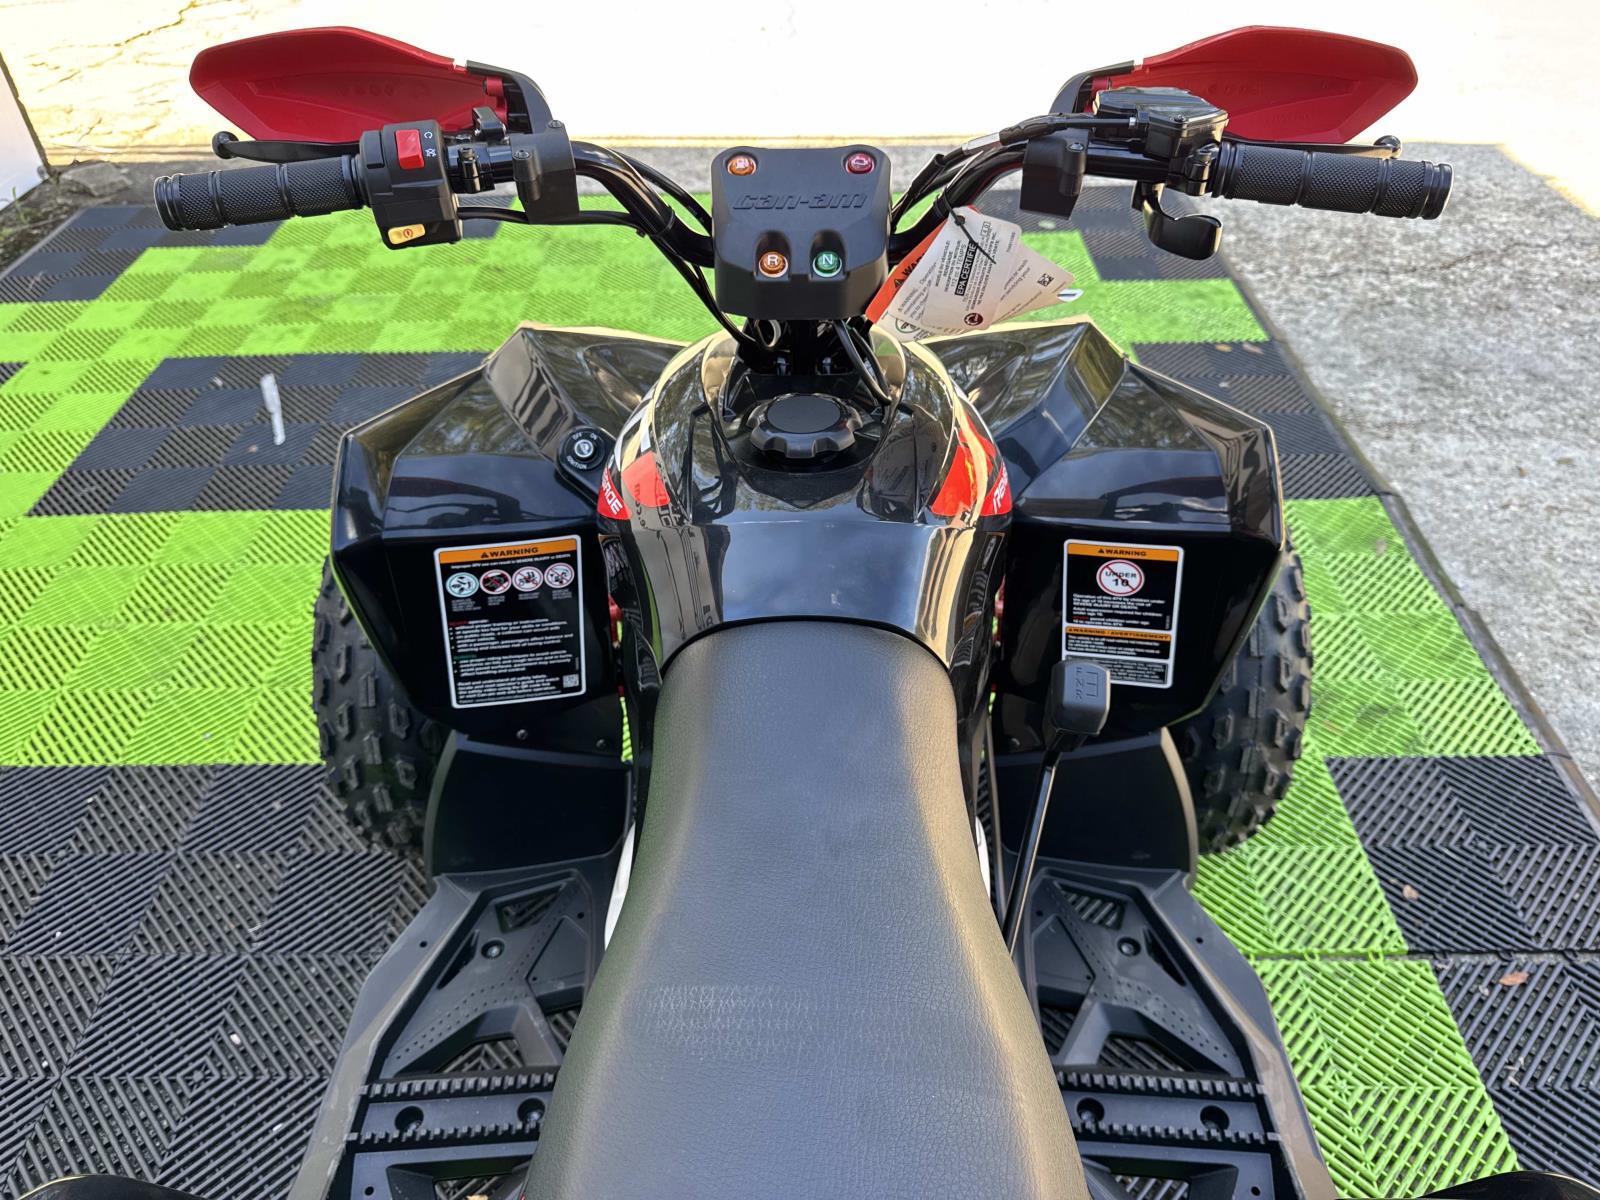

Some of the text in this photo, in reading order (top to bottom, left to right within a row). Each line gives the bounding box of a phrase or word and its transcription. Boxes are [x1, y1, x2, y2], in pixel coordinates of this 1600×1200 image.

[767, 254, 779, 266] R
[822, 253, 833, 265] N
[956, 279, 967, 295] EPA
[490, 547, 539, 558] WARNING
[1105, 548, 1147, 558] WARNING
